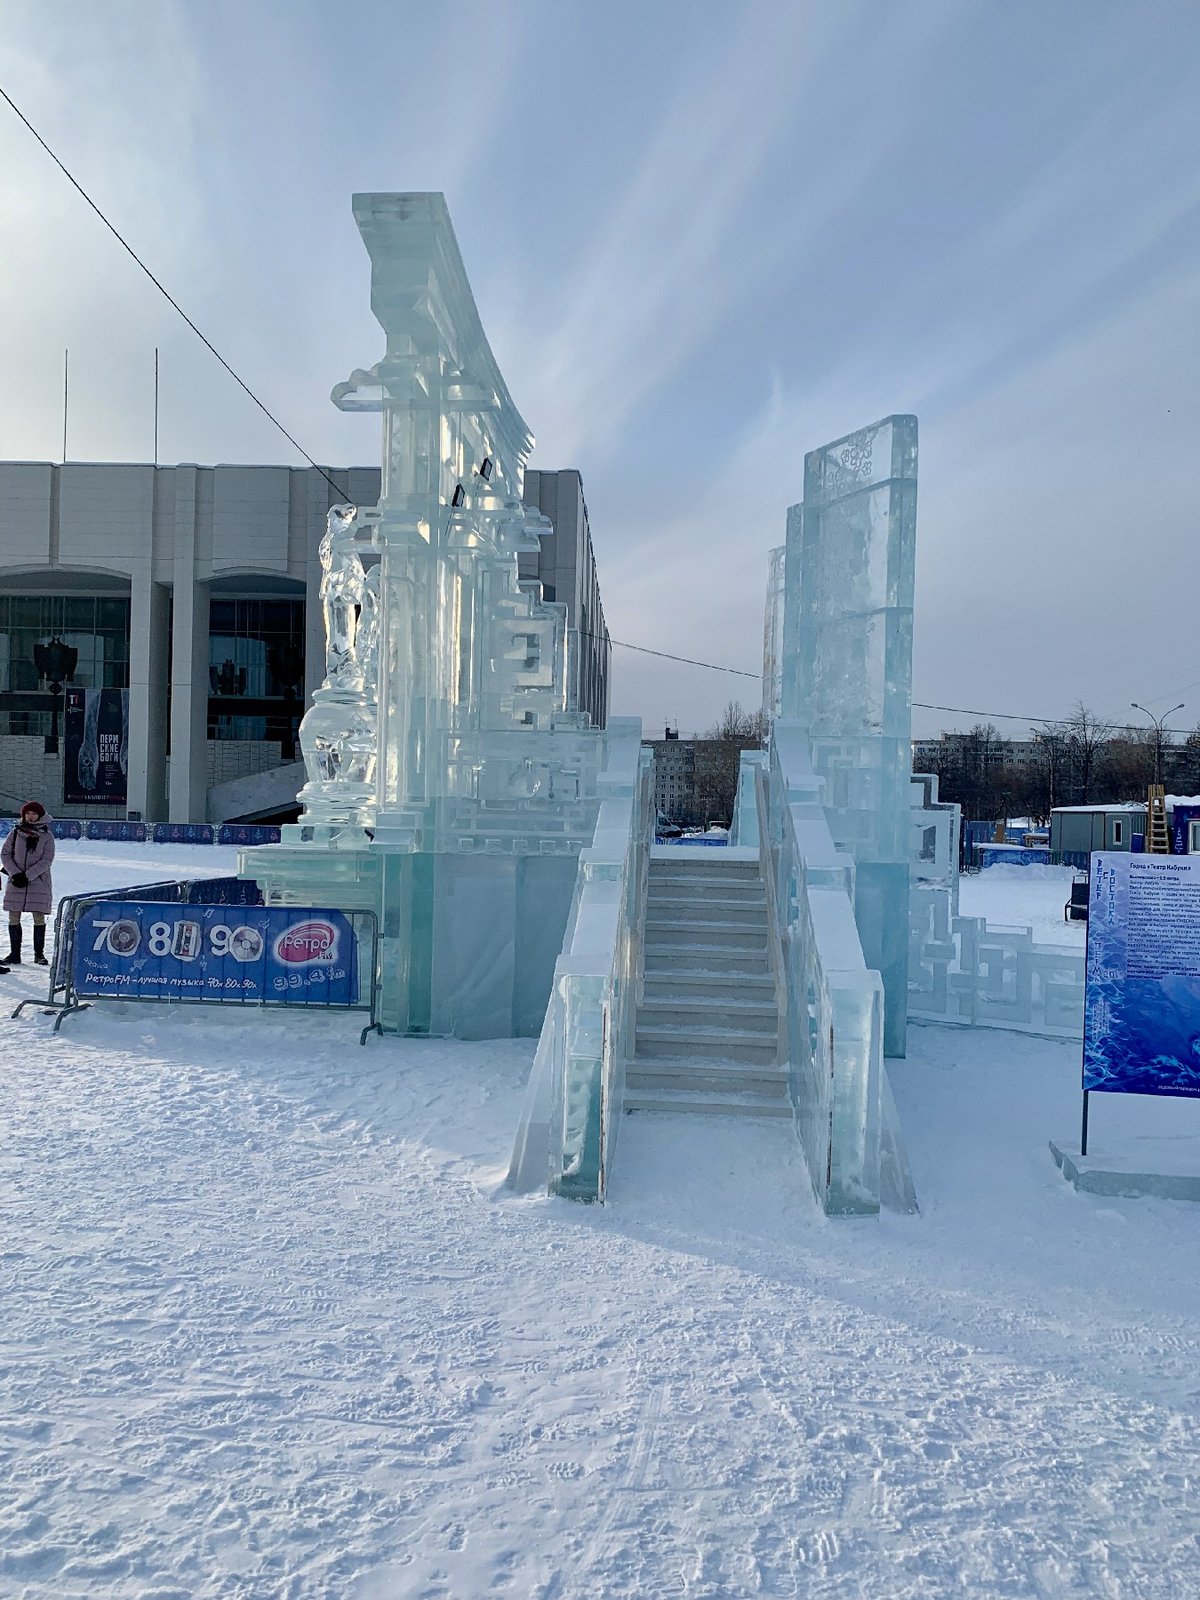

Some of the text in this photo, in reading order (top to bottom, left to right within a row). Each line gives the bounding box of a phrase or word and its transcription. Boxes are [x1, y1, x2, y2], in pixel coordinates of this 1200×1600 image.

[100, 734, 119, 744] ПЕРМ
[100, 744, 119, 752] СКИЕ
[100, 753, 119, 762] БОГИ
[1108, 868, 1116, 926] ВОСТОКА
[284, 935, 330, 952] Ретро
[170, 978, 204, 986] музыка
[274, 970, 325, 991] 99.4
